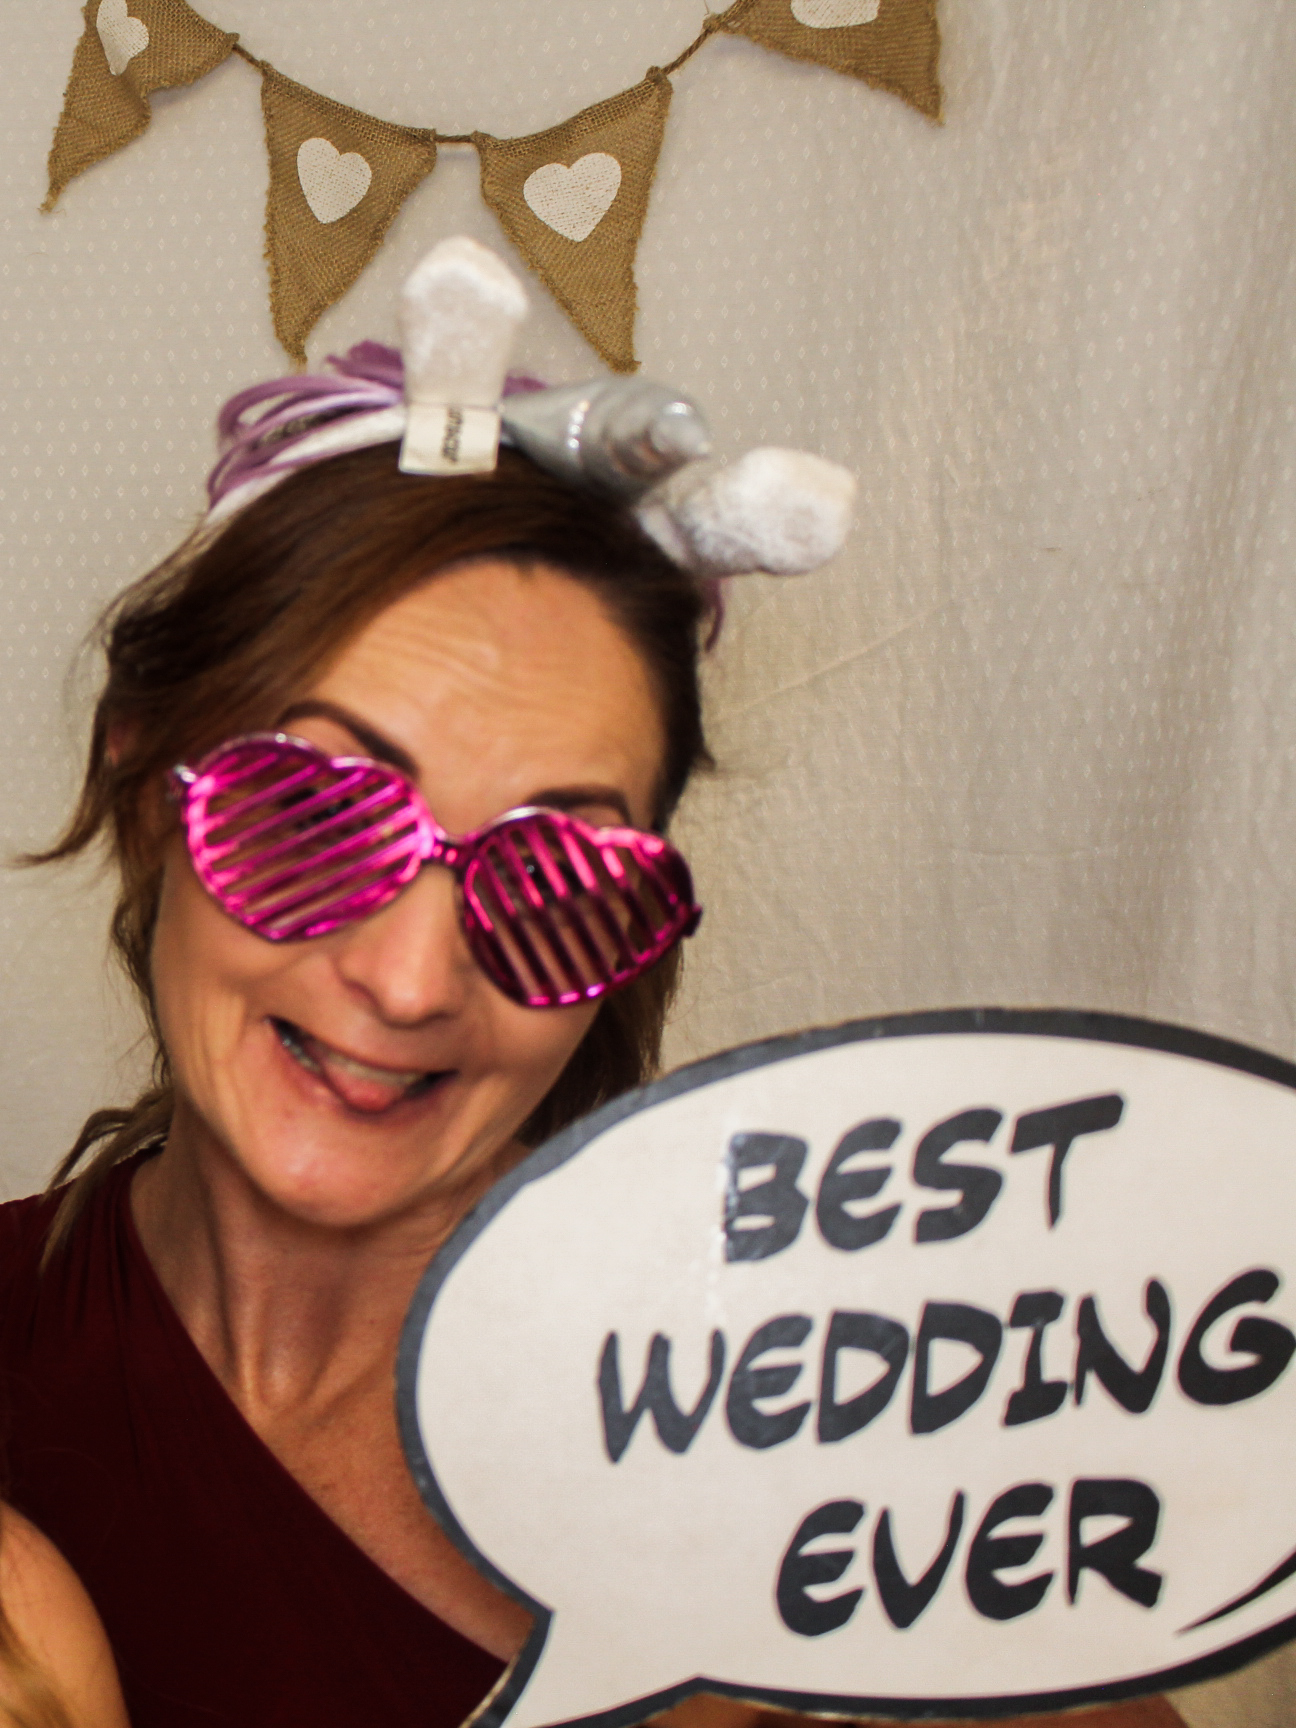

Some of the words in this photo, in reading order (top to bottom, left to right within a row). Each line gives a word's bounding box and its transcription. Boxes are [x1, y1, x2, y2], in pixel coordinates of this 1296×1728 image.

[723, 1092, 1125, 1263] BEST
[596, 1268, 1296, 1464] WEDDING
[774, 1477, 1163, 1638] EVER
